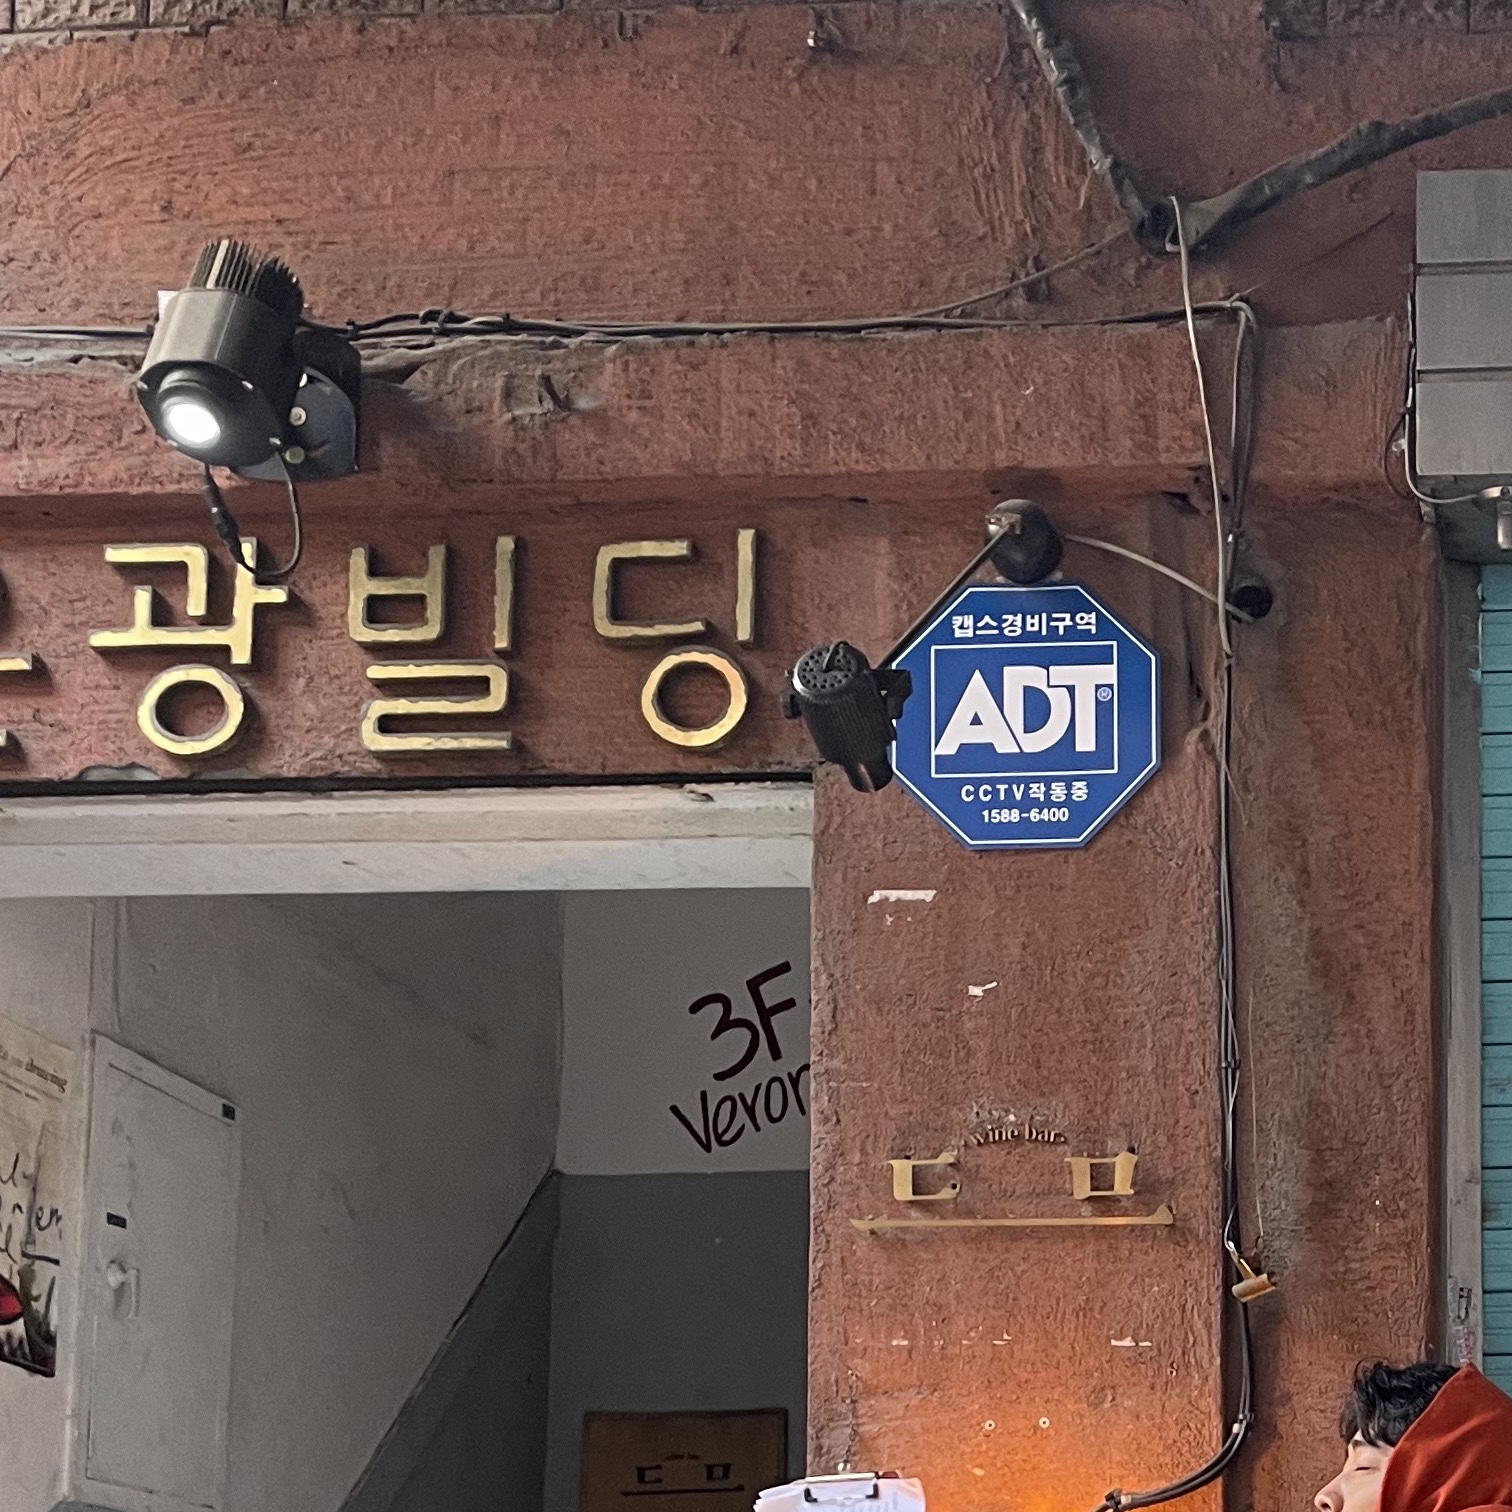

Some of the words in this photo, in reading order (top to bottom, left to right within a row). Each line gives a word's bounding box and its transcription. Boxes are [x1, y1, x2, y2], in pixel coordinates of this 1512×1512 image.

[952, 612, 1097, 638] 캡스경비구역
[934, 664, 1115, 756] ADT
[982, 808, 1069, 823] 1588-6400
[688, 961, 797, 1081] 3F
[968, 1124, 1019, 1146] wine
